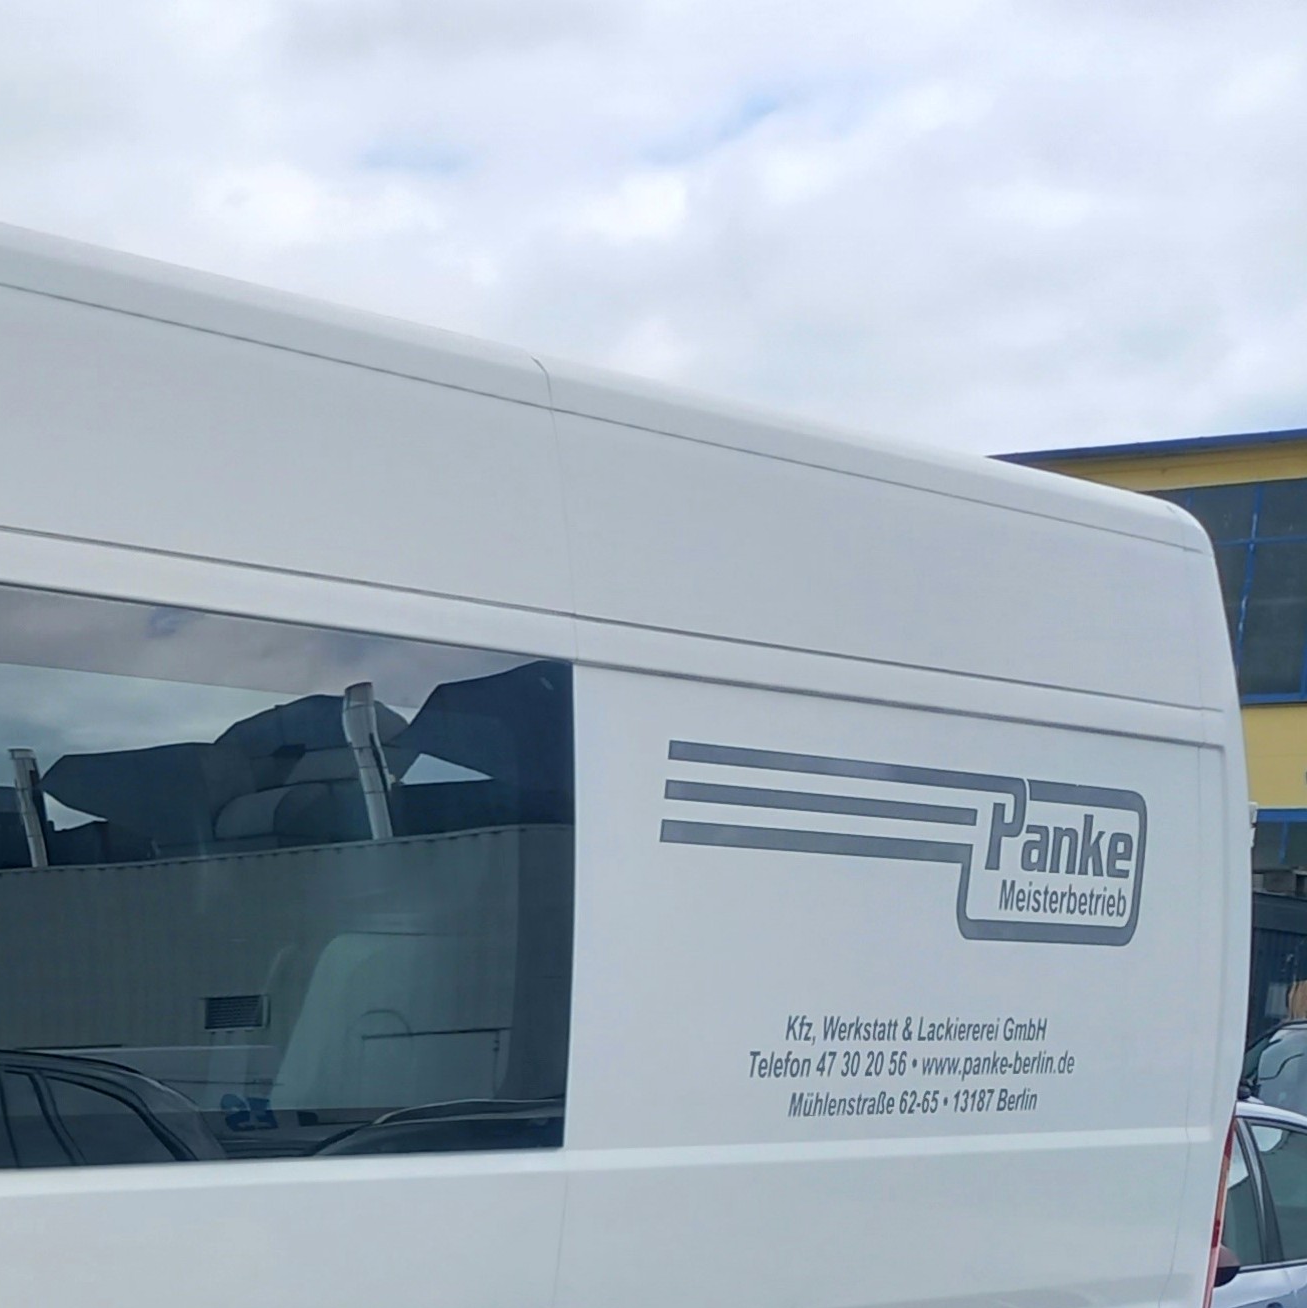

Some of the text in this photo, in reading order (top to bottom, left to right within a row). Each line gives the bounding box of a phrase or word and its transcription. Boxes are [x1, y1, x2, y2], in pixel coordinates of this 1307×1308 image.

[985, 780, 1134, 879] Panke
[999, 879, 1127, 917] Meisterbetrieb
[785, 1015, 1047, 1045] Kfz, Werkstatt & Lackiererei GmbH
[749, 1050, 1075, 1082] Telefon 47 30 20 56 www.panke-berlin.de
[788, 1086, 1038, 1117] Mühlenstraße 62-65 13187 Berlin
